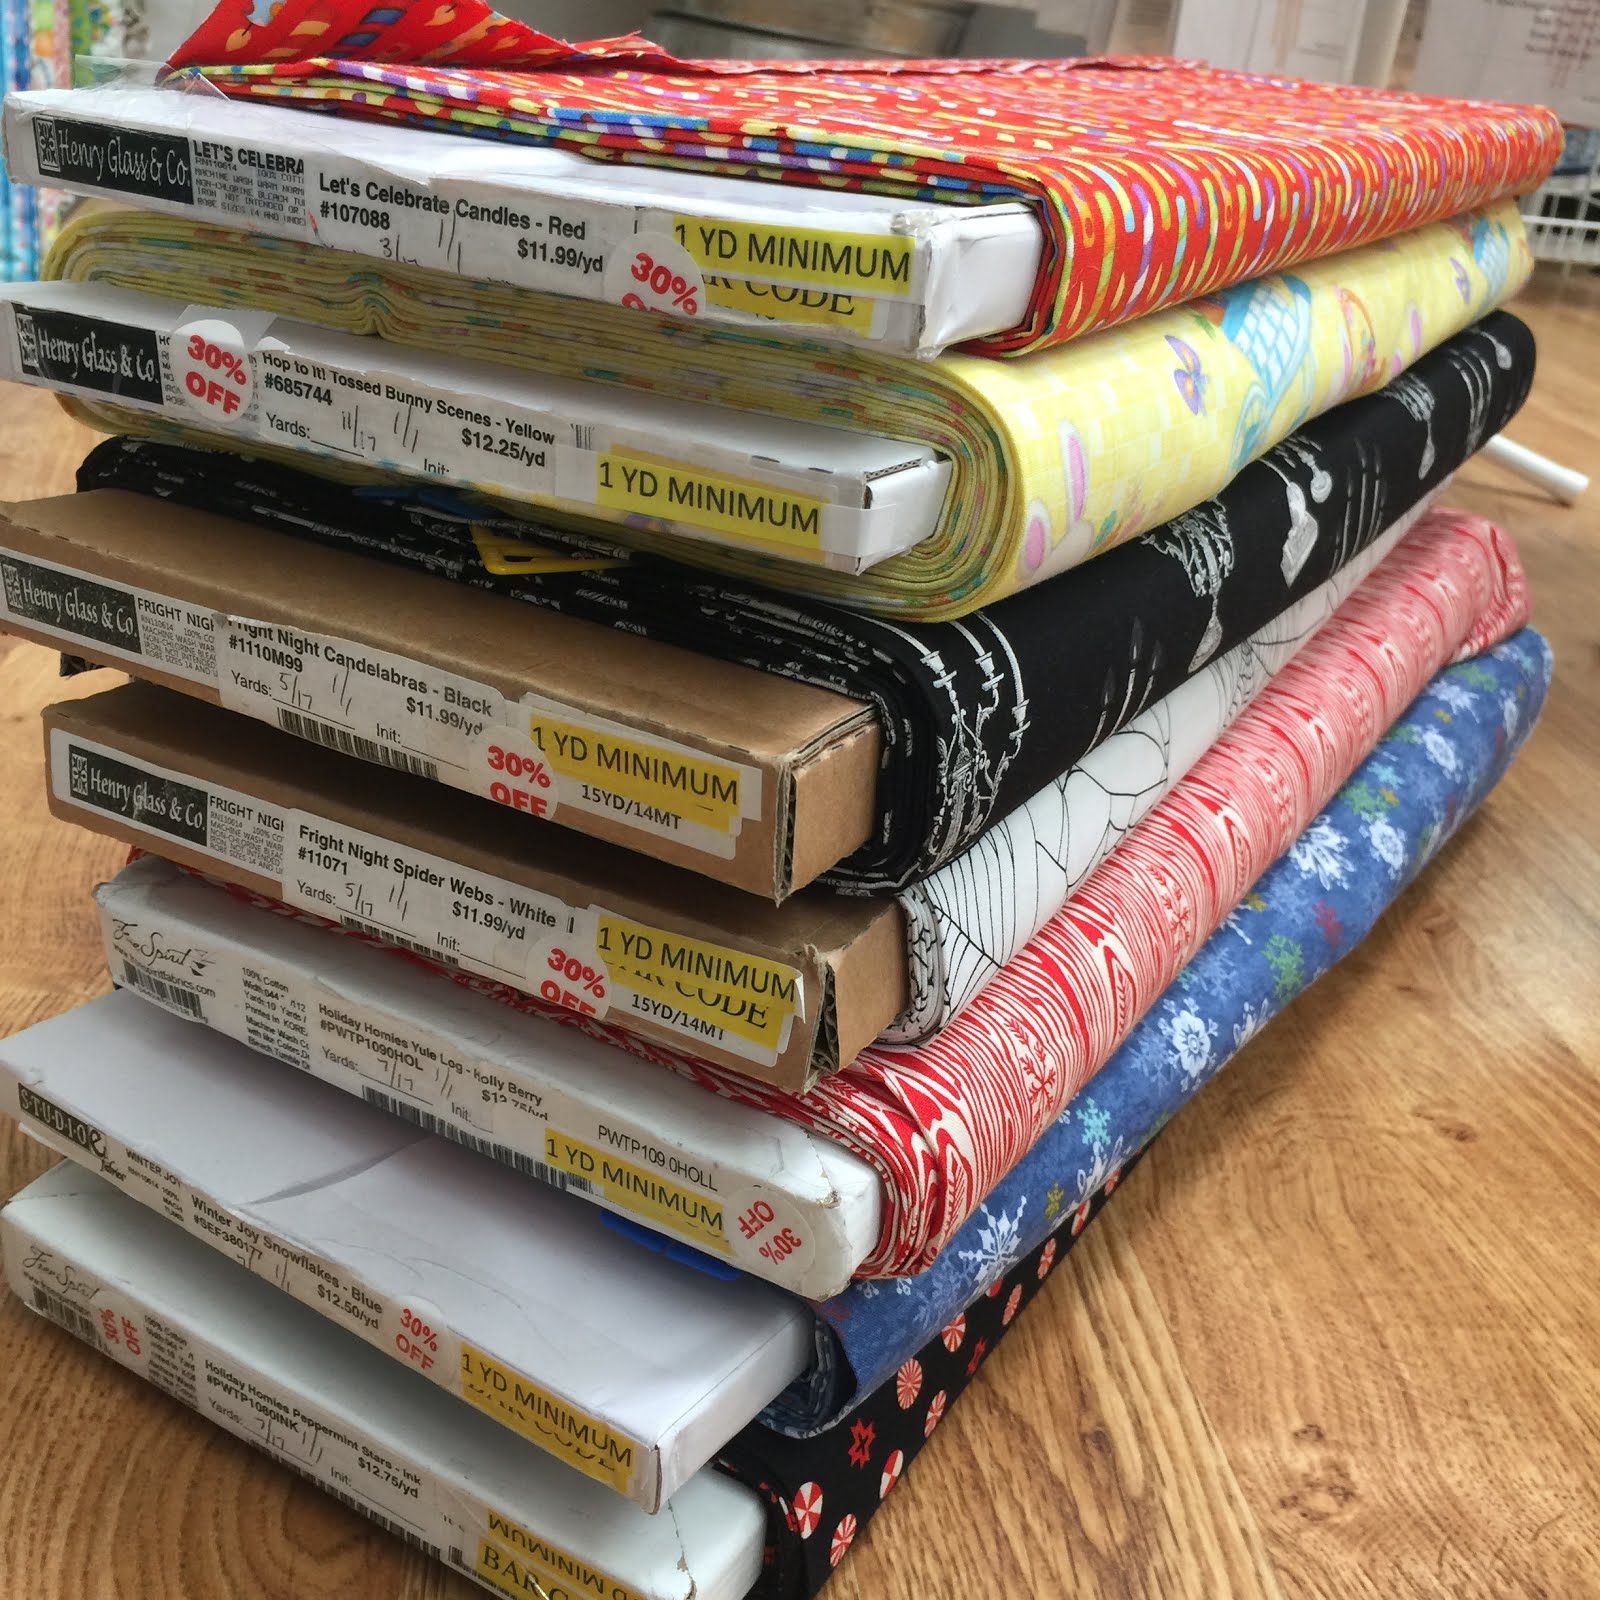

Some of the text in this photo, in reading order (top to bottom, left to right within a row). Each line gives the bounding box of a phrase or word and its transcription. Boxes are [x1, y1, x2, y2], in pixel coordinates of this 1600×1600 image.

[59, 130, 104, 181] Henry
[108, 136, 147, 182] Glass
[150, 147, 162, 185] &
[193, 140, 233, 162] LET'S
[320, 173, 360, 198] Let's
[366, 182, 449, 214] Celebrate
[456, 199, 530, 230] Candles
[549, 216, 586, 240] Red
[320, 201, 390, 230] #107088
[517, 238, 603, 274] $11.99/yd
[675, 224, 690, 253] 1
[700, 227, 737, 260] YD
[748, 233, 910, 283] MINIMUM
[630, 252, 698, 316] 30%
[38, 328, 79, 379] Henry
[82, 331, 116, 373] Glass
[121, 345, 133, 378] &
[187, 334, 247, 386] 30%
[186, 371, 241, 414] OFF
[263, 352, 290, 372] Hop
[295, 361, 309, 375] to
[312, 363, 326, 381] It!
[330, 370, 381, 396] Tossed
[385, 385, 432, 413] Bunny
[437, 400, 491, 427] Scenes
[505, 418, 555, 445] Yellow
[264, 373, 333, 406] #685744
[266, 413, 311, 440] Yards:
[462, 428, 546, 468] $12.25/yd
[600, 462, 818, 534] 1 YD MINIMUM
[22, 578, 138, 637] Henry Glass & Co.
[138, 598, 181, 621] FRIGHT
[229, 634, 303, 673] #1110M99
[277, 630, 320, 657] Night
[324, 645, 428, 694] Candelabras
[444, 686, 492, 717] Black
[231, 670, 272, 697] Yards:
[376, 723, 401, 744] Init:
[406, 697, 482, 736] $11.99/yd
[488, 744, 551, 789] 30%
[533, 726, 738, 805] 1 YD MINIMUM
[90, 768, 206, 831] Henry Glass & Co.
[210, 796, 253, 820] FRIGHT
[490, 781, 548, 817] OFF
[581, 784, 682, 830] 15YD/14MT
[298, 846, 348, 876] #11071
[299, 824, 344, 854] Fright
[348, 842, 390, 870] Night
[393, 858, 445, 888] Spider
[450, 876, 494, 907] Webs
[510, 898, 556, 928] White
[297, 879, 336, 906] Yards:
[437, 931, 461, 953] Init:
[452, 901, 526, 940] $11.99/yd
[547, 947, 606, 999] 30%
[598, 926, 611, 951] 1
[621, 931, 652, 960] YD
[661, 943, 796, 1003] MINIMUM
[540, 979, 597, 1018] OFF
[631, 994, 725, 1041] 15YD/14MT
[318, 1003, 361, 1032] Holiday
[364, 1022, 409, 1049] Homies
[411, 1040, 437, 1061] Yule
[440, 1053, 463, 1074] Log
[508, 1081, 543, 1107] Berry
[320, 1019, 423, 1072] #PWTP1090HOL
[321, 1046, 359, 1072] Yards:
[451, 1101, 473, 1123] Init:
[126, 1148, 162, 1177] WINTER
[598, 1124, 718, 1193] PWTP109.0HOLL
[547, 1138, 723, 1232] 1 YD MINIMUM
[737, 1199, 775, 1240] OFF
[191, 1195, 233, 1228] Winter
[236, 1220, 261, 1244] Joy
[263, 1236, 340, 1288] Snowflakes
[351, 1286, 384, 1315] Blue
[758, 1227, 802, 1266] 30%
[99, 1308, 120, 1344] 30%
[317, 1284, 379, 1330] $12.50/yd
[121, 1316, 141, 1356] OFF
[395, 1333, 435, 1370] OFF
[399, 1308, 438, 1353] 30%
[205, 1360, 245, 1390] Holiday
[248, 1383, 290, 1415] Homies
[292, 1408, 359, 1451] Peppermint
[361, 1445, 392, 1470] Stars
[402, 1468, 422, 1485] Ink
[208, 1396, 244, 1427] Yards:
[462, 1353, 632, 1468] 1 YD MINIMUM
[330, 1465, 353, 1488] Init:
[357, 1456, 420, 1499] $12.75/yd
[489, 1514, 604, 1595] MINIMUM
